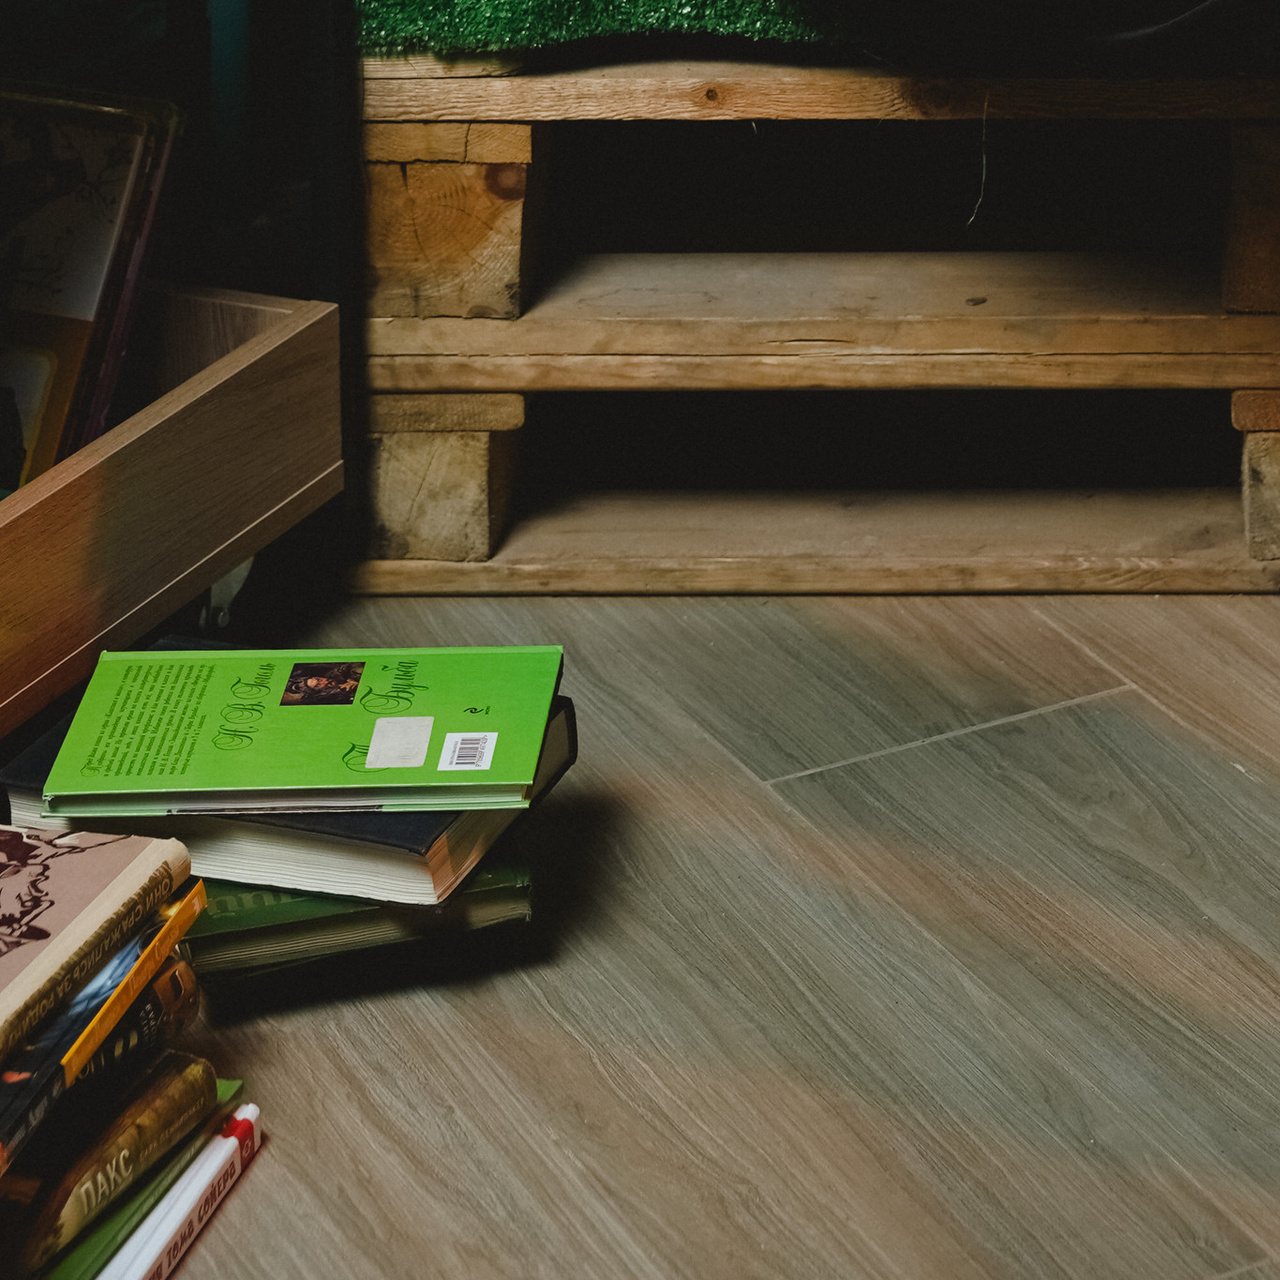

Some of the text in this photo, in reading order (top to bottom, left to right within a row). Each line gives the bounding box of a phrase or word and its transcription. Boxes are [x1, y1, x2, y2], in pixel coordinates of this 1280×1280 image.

[230, 662, 277, 700] Гоголь
[359, 659, 430, 715] Бульба
[145, 877, 171, 911] ОНИ
[73, 905, 144, 981] СРАЖАЛИСЬ
[57, 979, 73, 996] ЗА
[79, 1148, 134, 1216] ПАКС
